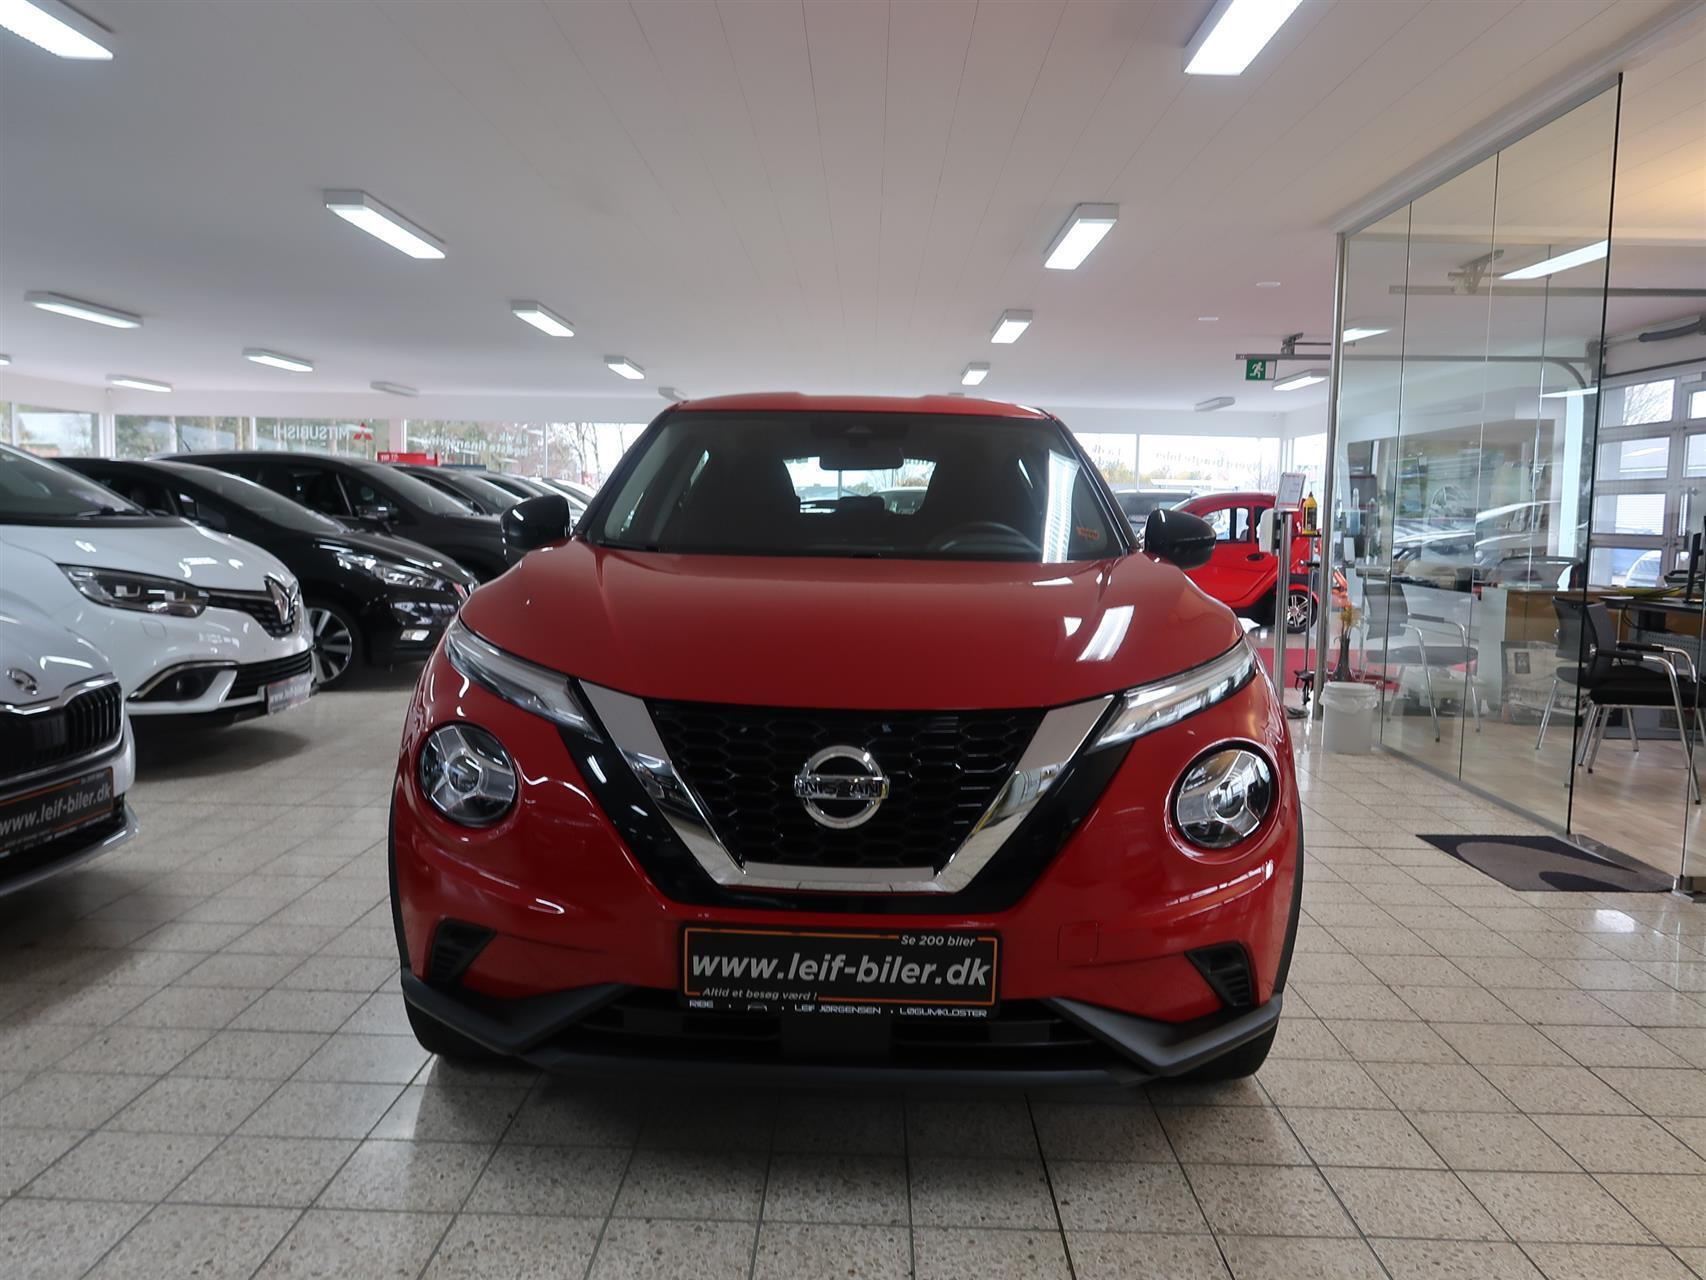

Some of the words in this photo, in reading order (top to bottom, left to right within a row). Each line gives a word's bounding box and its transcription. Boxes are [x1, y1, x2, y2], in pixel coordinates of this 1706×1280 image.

[805, 780, 879, 794] NISAN
[901, 935, 916, 946] Se
[919, 936, 944, 946] 200
[947, 936, 976, 947] biler
[692, 953, 991, 985] www.leif-biler.dk
[703, 988, 730, 998] Altid
[732, 989, 744, 998] et
[746, 989, 779, 1001] besøg
[782, 990, 811, 1001] værd
